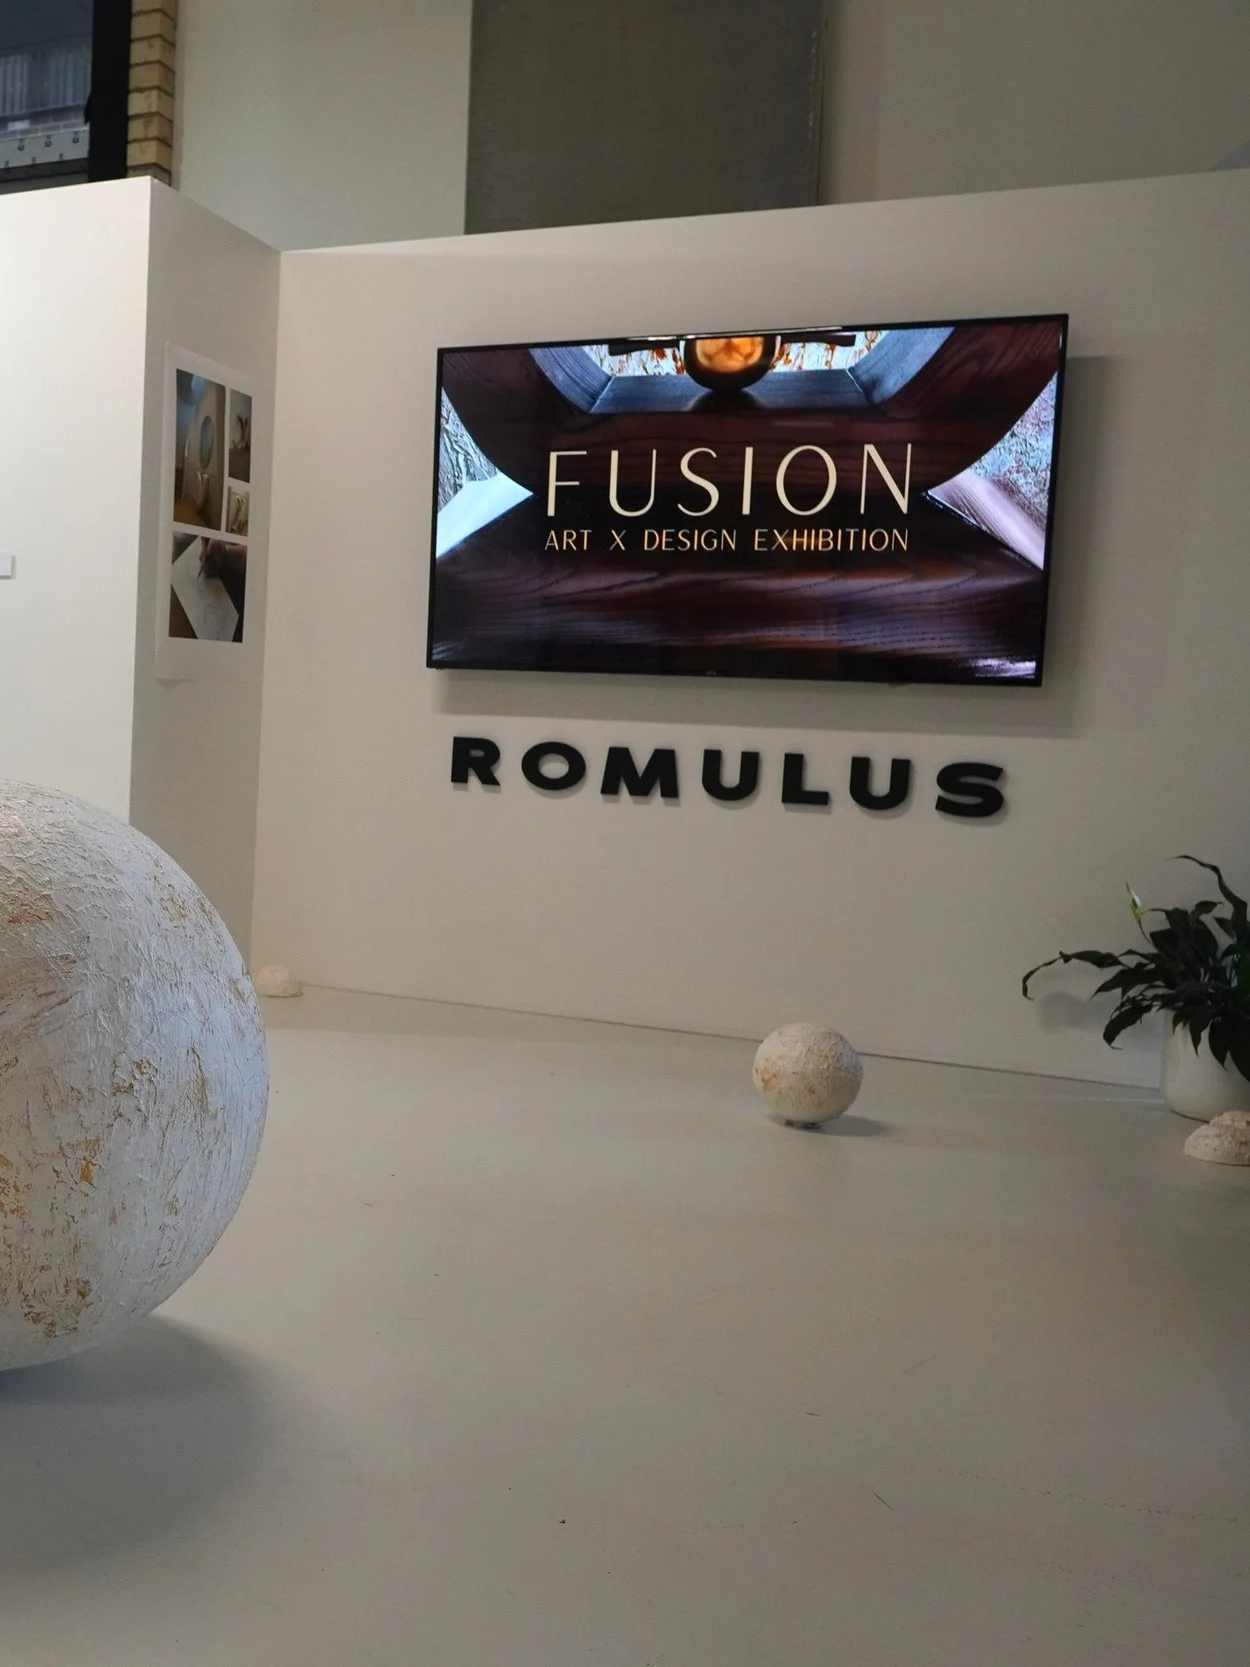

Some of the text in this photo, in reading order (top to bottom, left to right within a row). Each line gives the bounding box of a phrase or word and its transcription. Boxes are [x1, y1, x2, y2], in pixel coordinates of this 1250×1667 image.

[546, 442, 913, 517] FUSION
[544, 527, 910, 552] ART X DESIGN EXHIBITION
[450, 736, 1006, 818] ROMULUS
